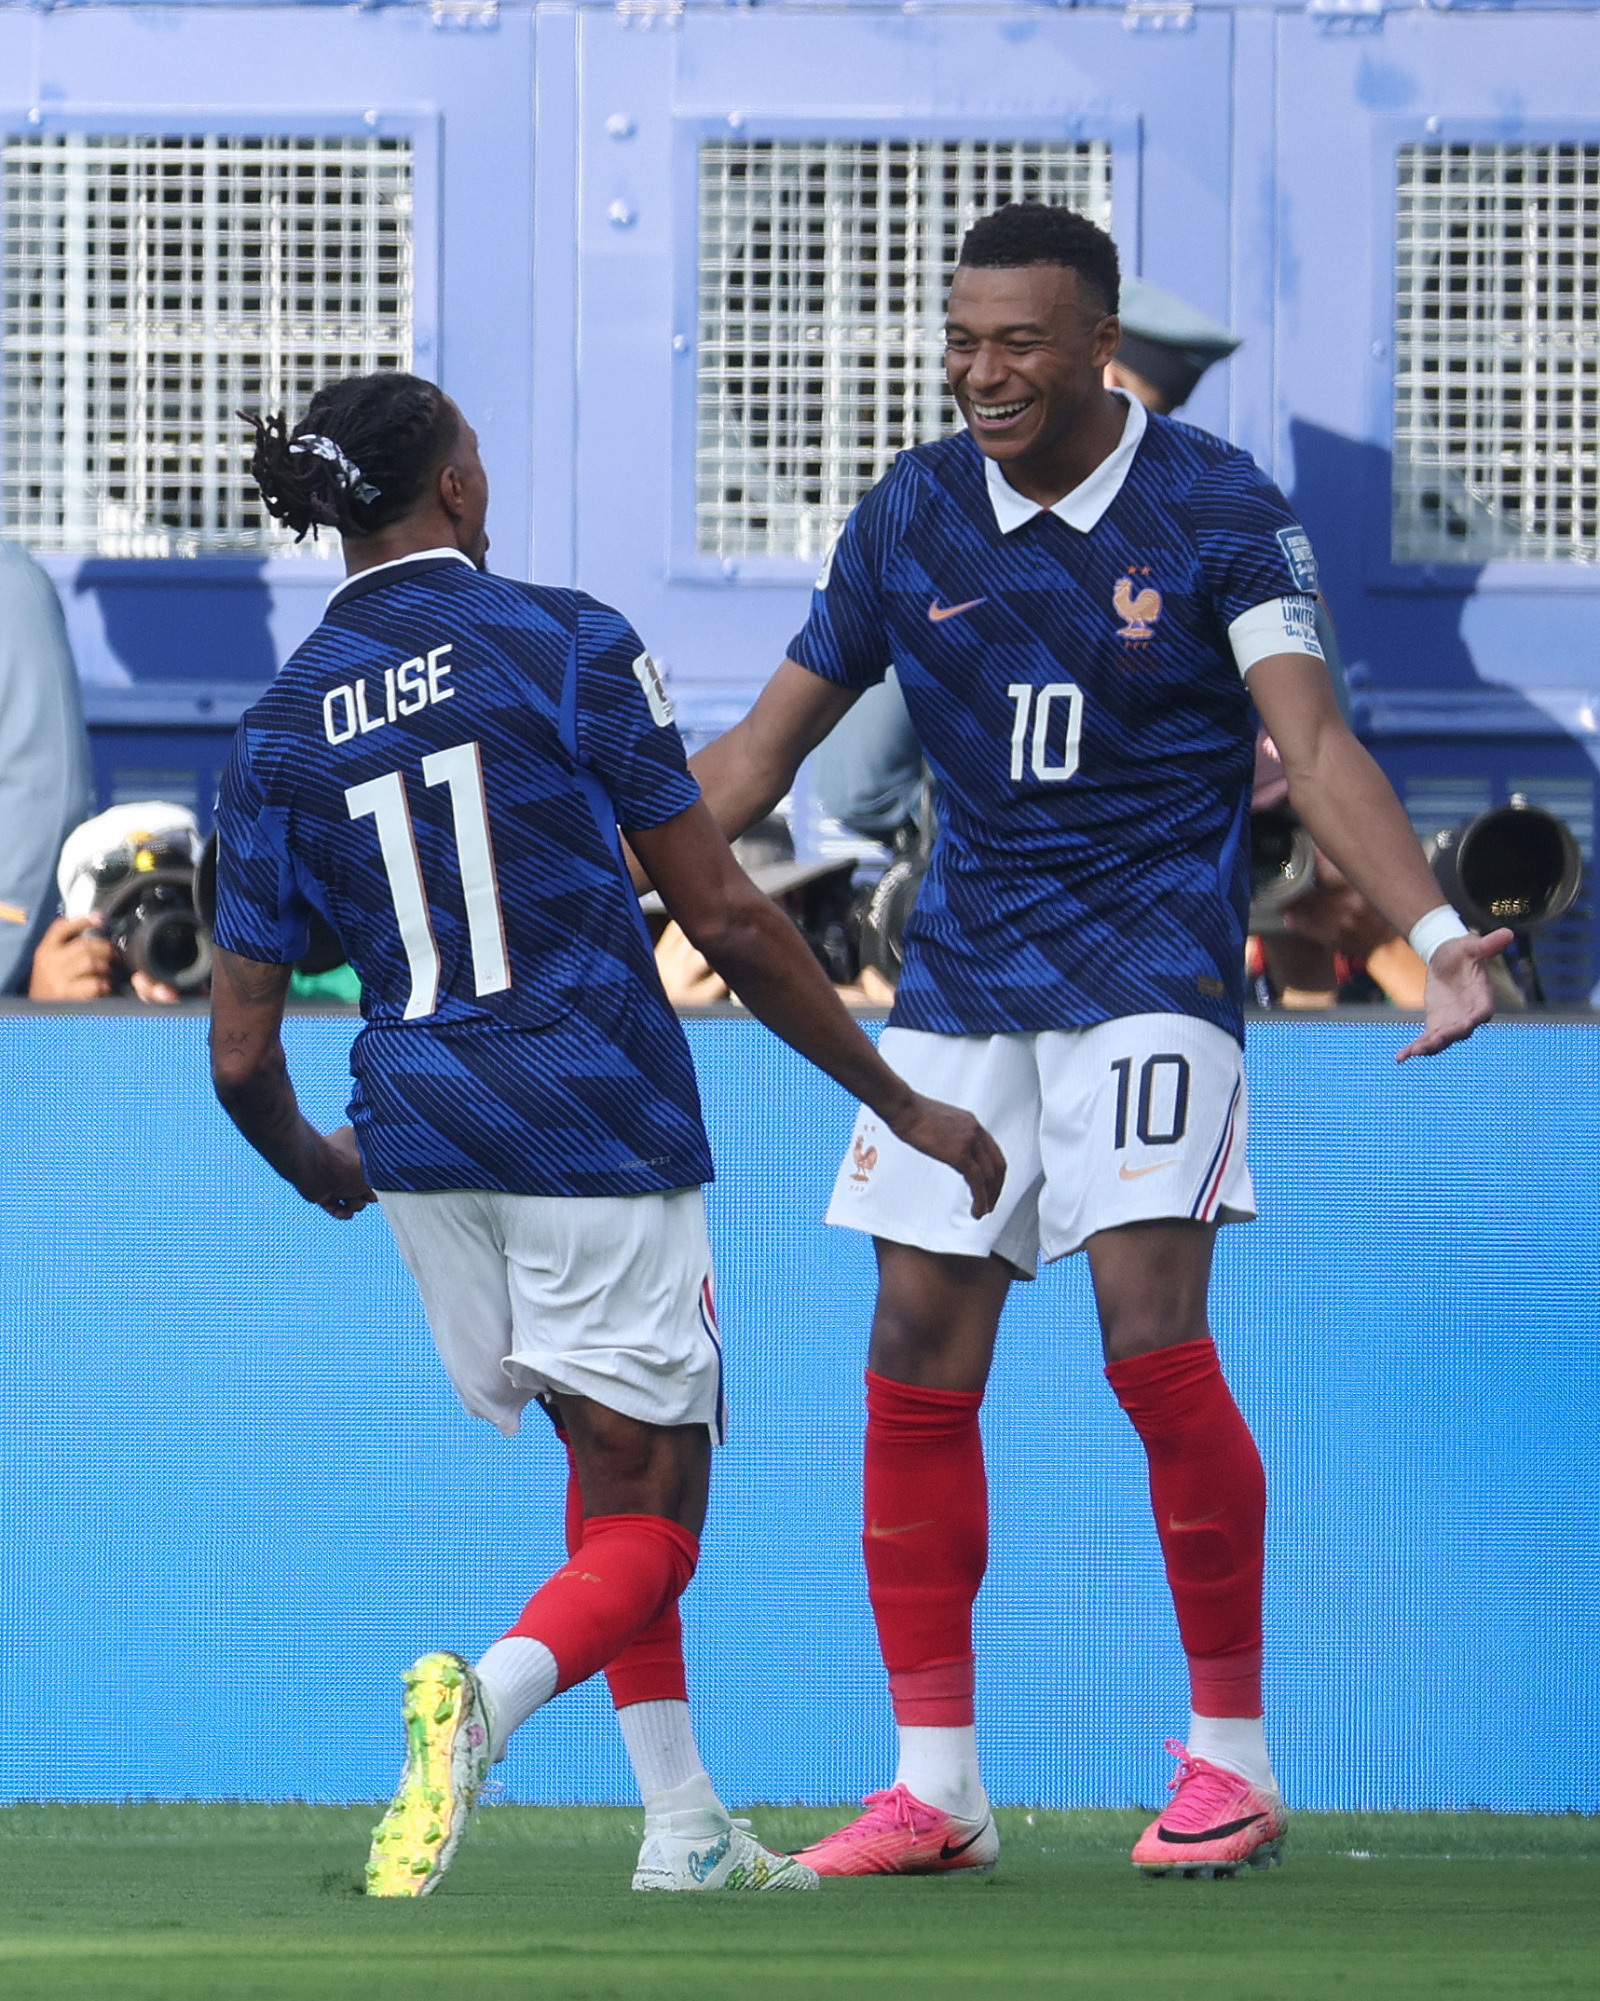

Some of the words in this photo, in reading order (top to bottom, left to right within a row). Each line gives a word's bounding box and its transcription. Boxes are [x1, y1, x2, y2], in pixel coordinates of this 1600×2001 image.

[323, 643, 455, 745] OLISE
[1008, 683, 1084, 781] 10
[344, 740, 511, 1020] 11
[1110, 1052, 1190, 1150] 10
